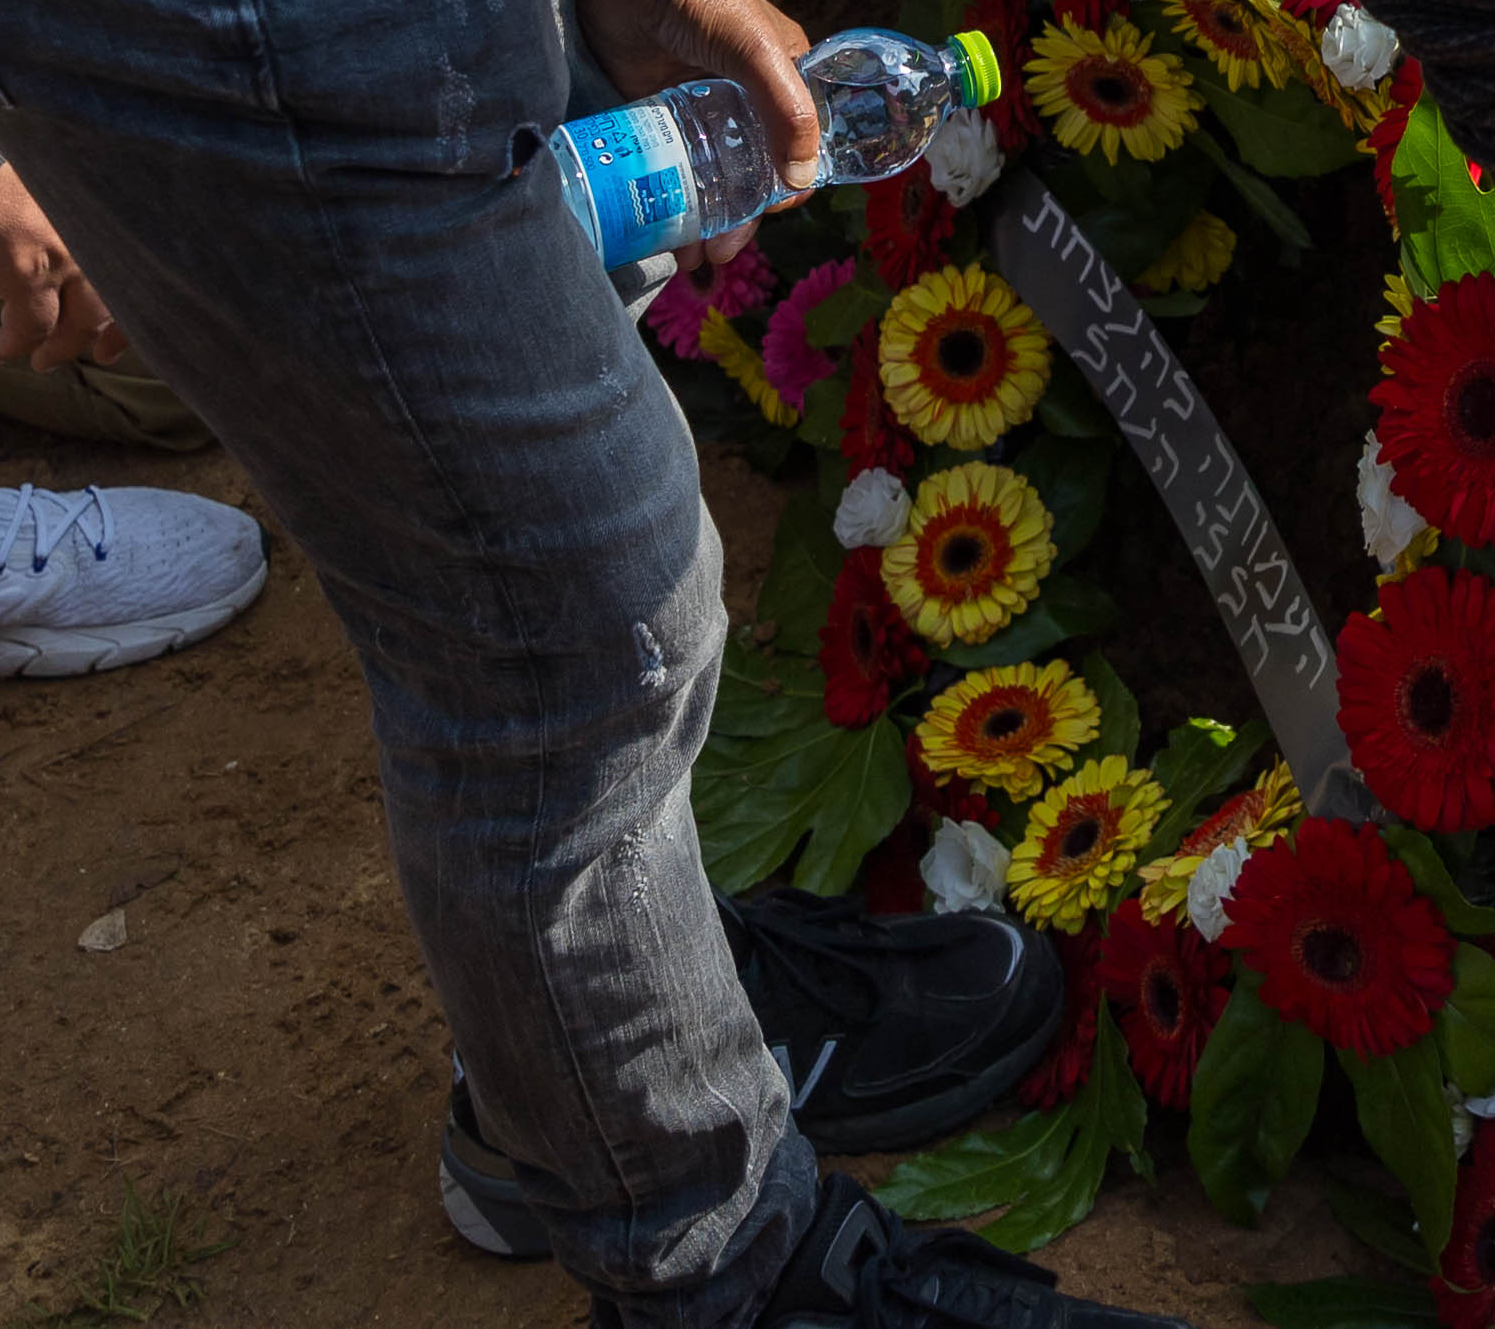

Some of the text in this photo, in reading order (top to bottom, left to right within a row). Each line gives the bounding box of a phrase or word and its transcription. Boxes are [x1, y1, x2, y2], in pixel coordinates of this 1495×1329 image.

[1023, 191, 1328, 690] העמותה להנצחת
[1072, 323, 1270, 677] חללי הנחל
